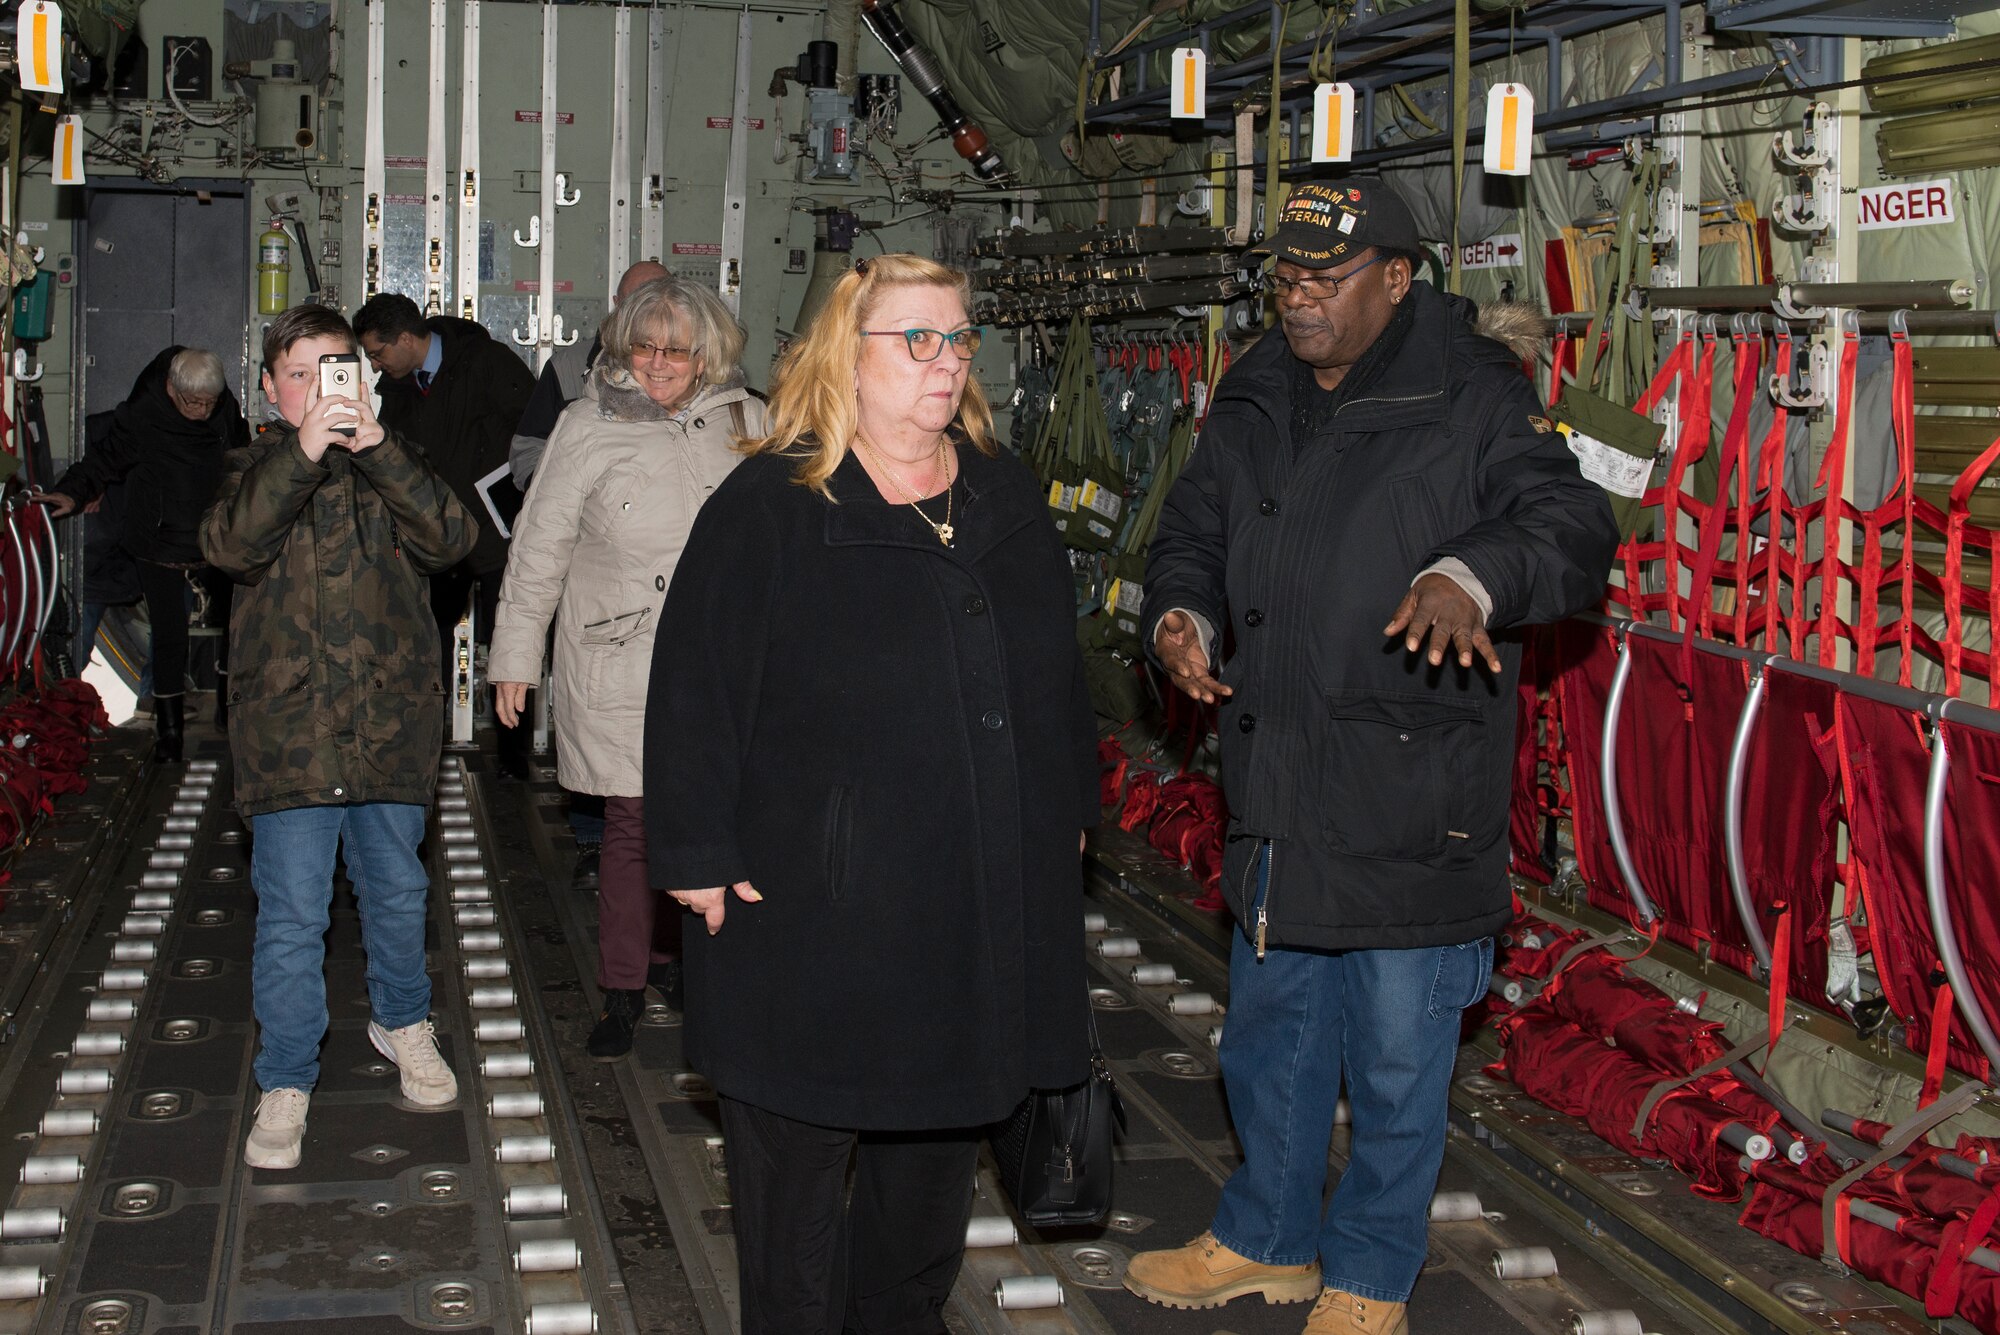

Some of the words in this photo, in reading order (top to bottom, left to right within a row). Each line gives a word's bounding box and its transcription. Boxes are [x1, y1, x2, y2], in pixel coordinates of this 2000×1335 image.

[1858, 187, 1948, 225] NGER
[1287, 246, 1331, 260] VIETNAM
[1330, 242, 1348, 255] VET
[1442, 241, 1494, 268] DGER
